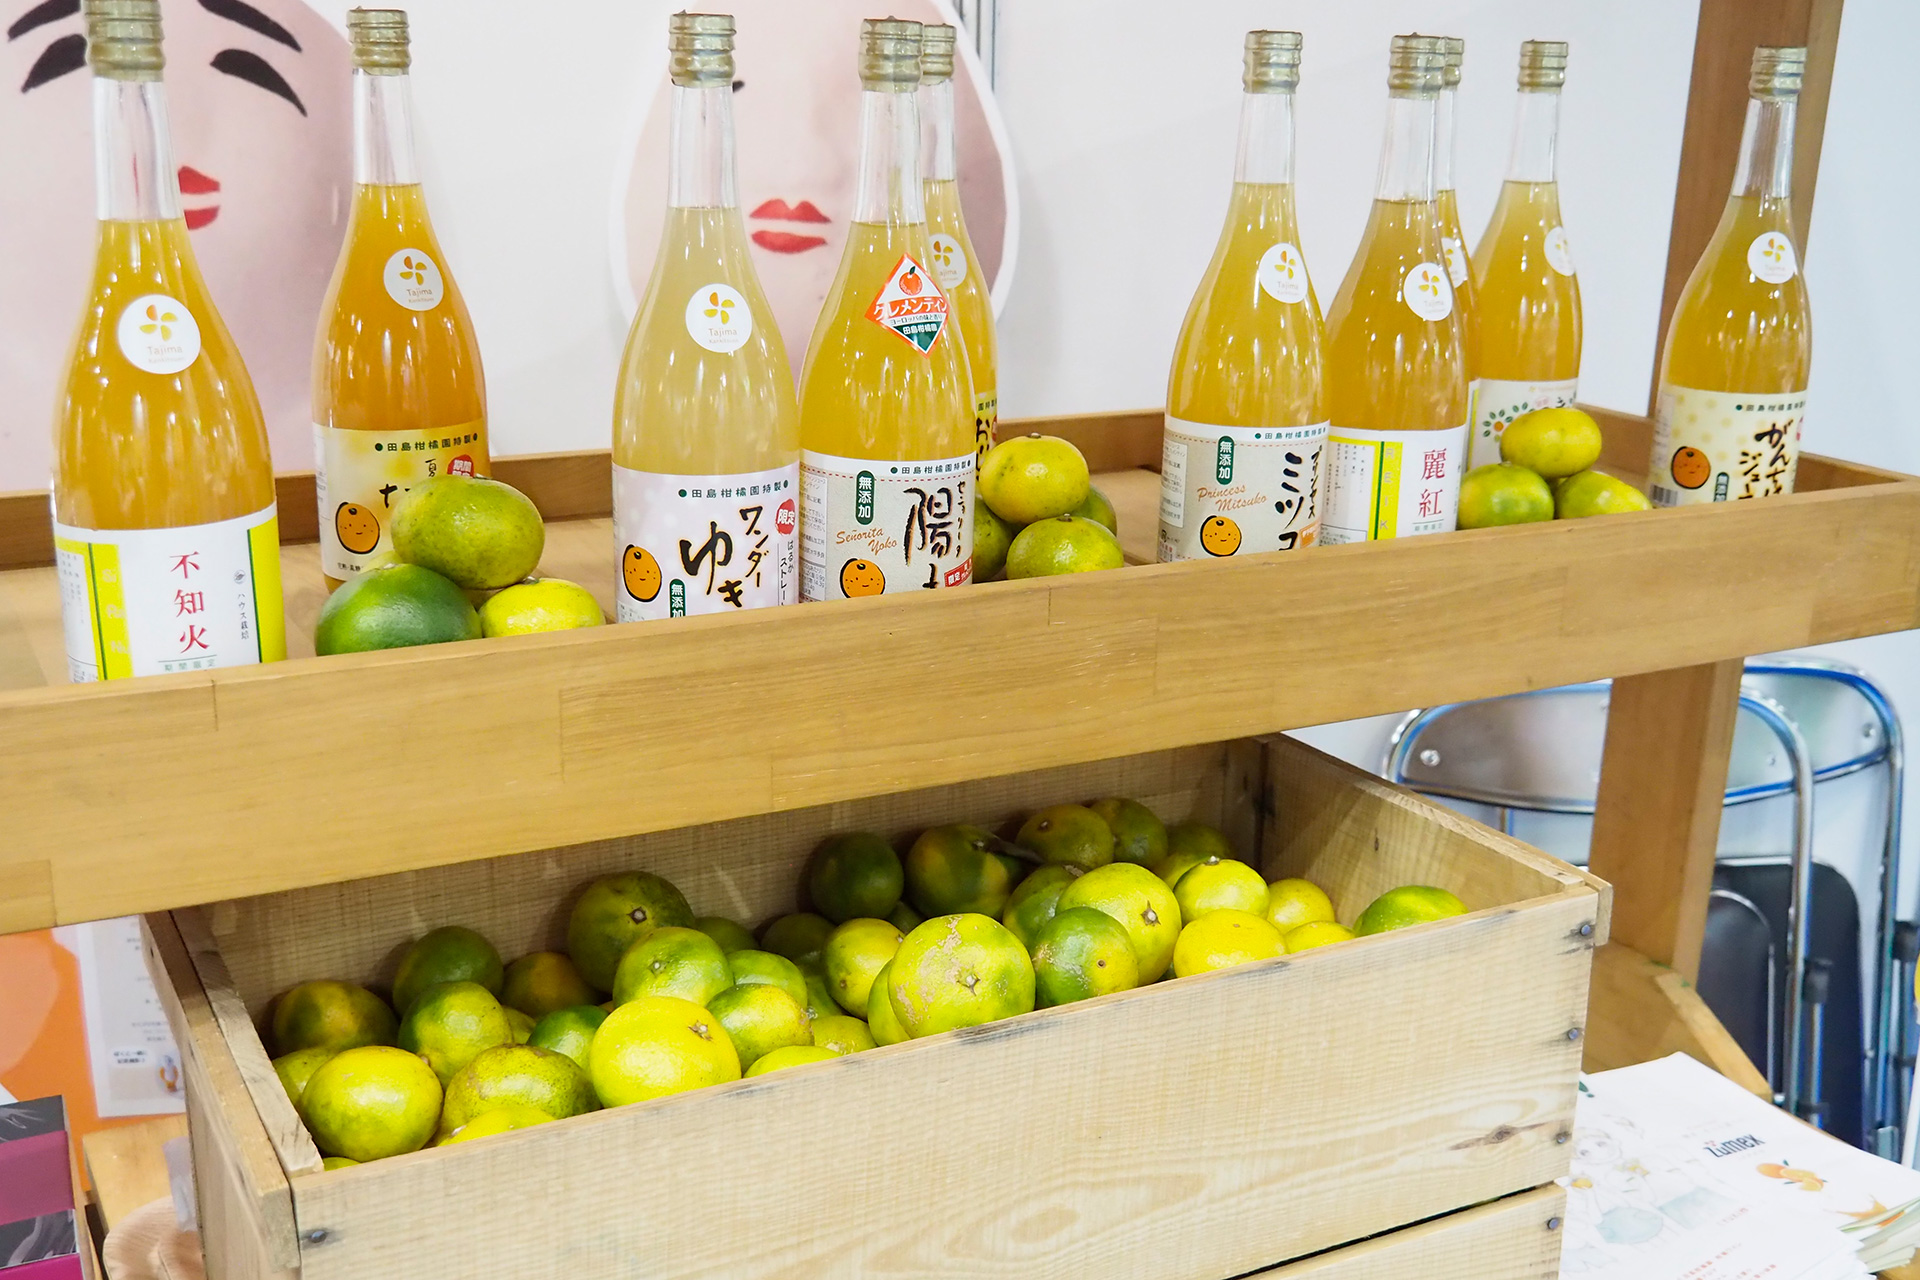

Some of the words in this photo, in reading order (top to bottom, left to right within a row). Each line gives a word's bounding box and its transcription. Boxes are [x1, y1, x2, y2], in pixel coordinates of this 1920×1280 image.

[407, 288, 433, 297] Tajima
[709, 328, 737, 337] Tajima
[147, 346, 183, 356] Tajima
[387, 434, 471, 452] 田島柑橘園特製
[901, 461, 967, 475] 田島柑橘園特製
[1218, 440, 1232, 479] 無添加
[691, 481, 782, 499] 田島柑橘園特製
[1417, 448, 1447, 517] 麗紅
[858, 475, 872, 518] 無添加
[1197, 484, 1246, 501] Princess
[1275, 452, 1304, 551] ミツコ
[1215, 493, 1267, 512] Mitsuko
[776, 508, 795, 526] 限定
[836, 528, 884, 544] Señorita
[868, 536, 898, 555] Yoko
[739, 505, 770, 588] ワンダー
[679, 520, 744, 608] ゆき
[780, 557, 788, 606] ストレー
[169, 551, 210, 653] 不知火
[237, 592, 249, 640] ハウス栽培
